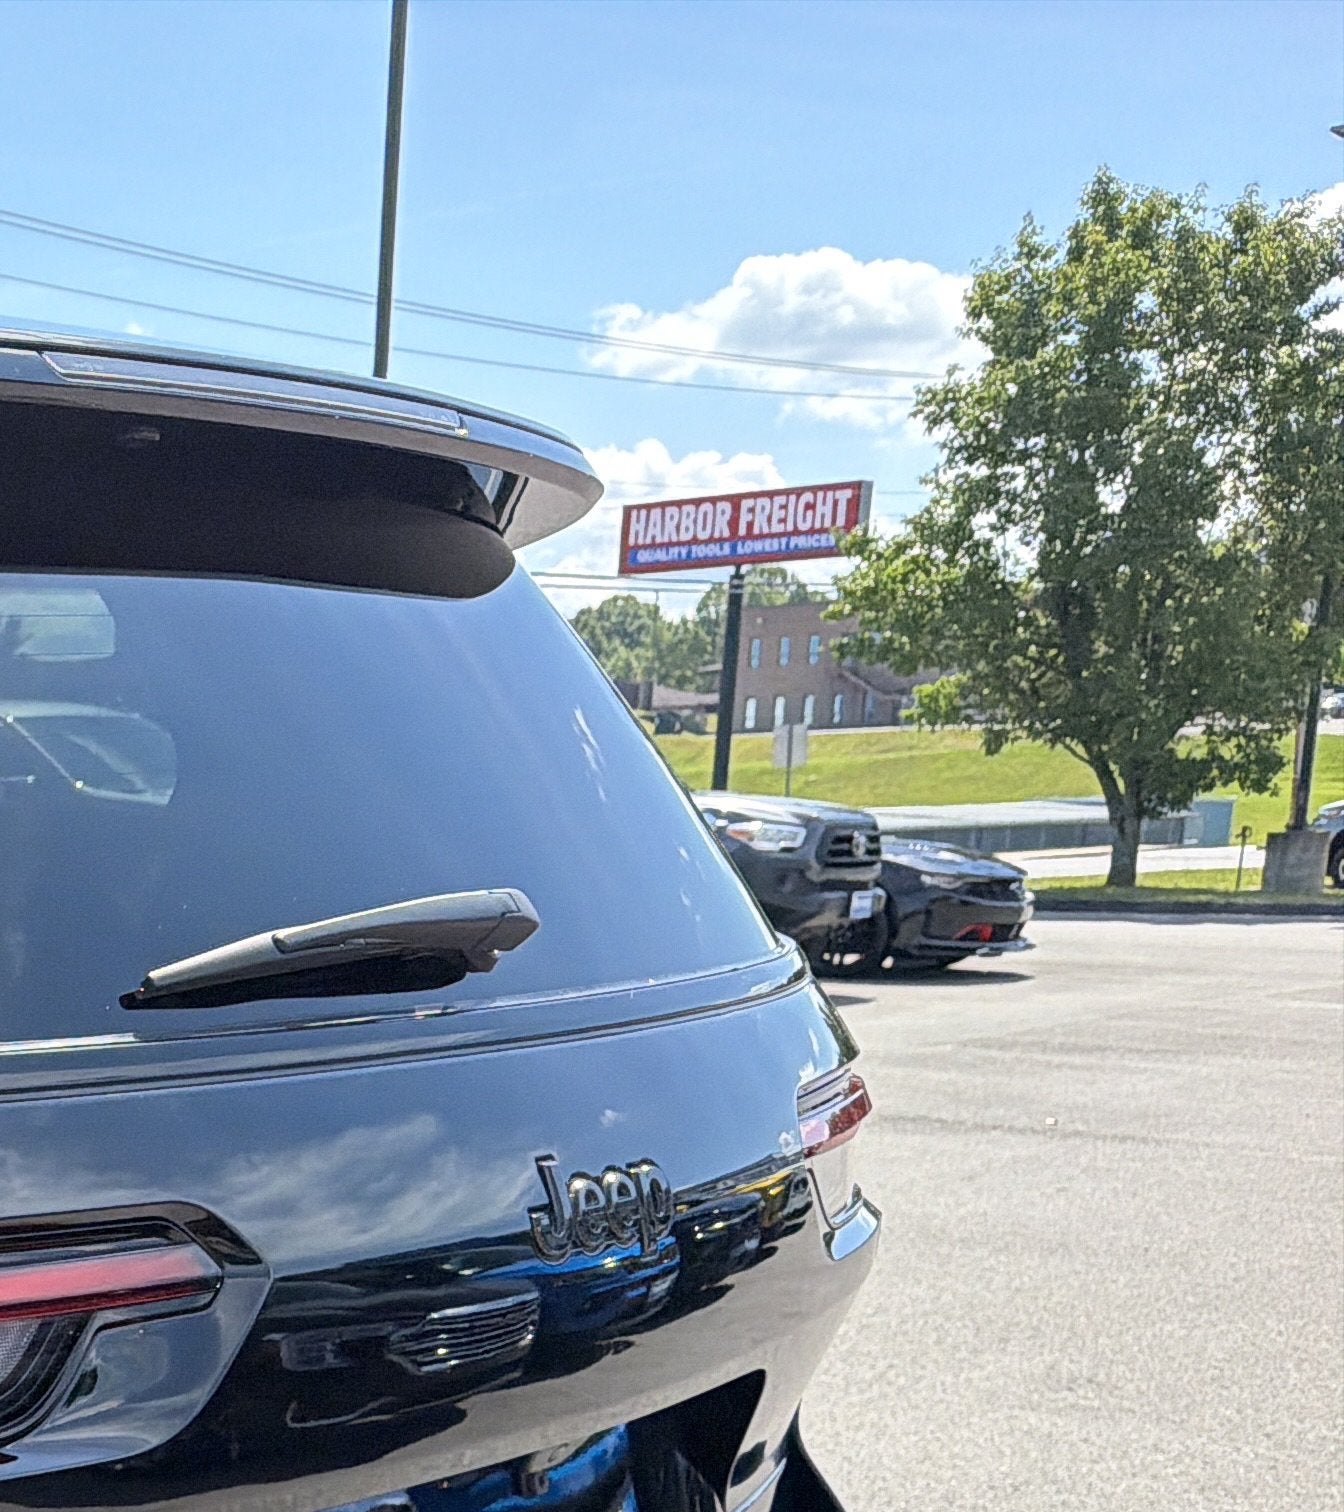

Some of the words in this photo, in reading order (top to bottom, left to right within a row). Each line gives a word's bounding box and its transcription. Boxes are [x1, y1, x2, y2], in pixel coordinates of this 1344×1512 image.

[628, 501, 732, 546] HARBOR
[737, 488, 853, 536] FREIGHT
[636, 545, 689, 563] QUALITY
[691, 542, 731, 559] TOOLS
[736, 536, 787, 555] LOWEST
[527, 1153, 674, 1266] Jeep
